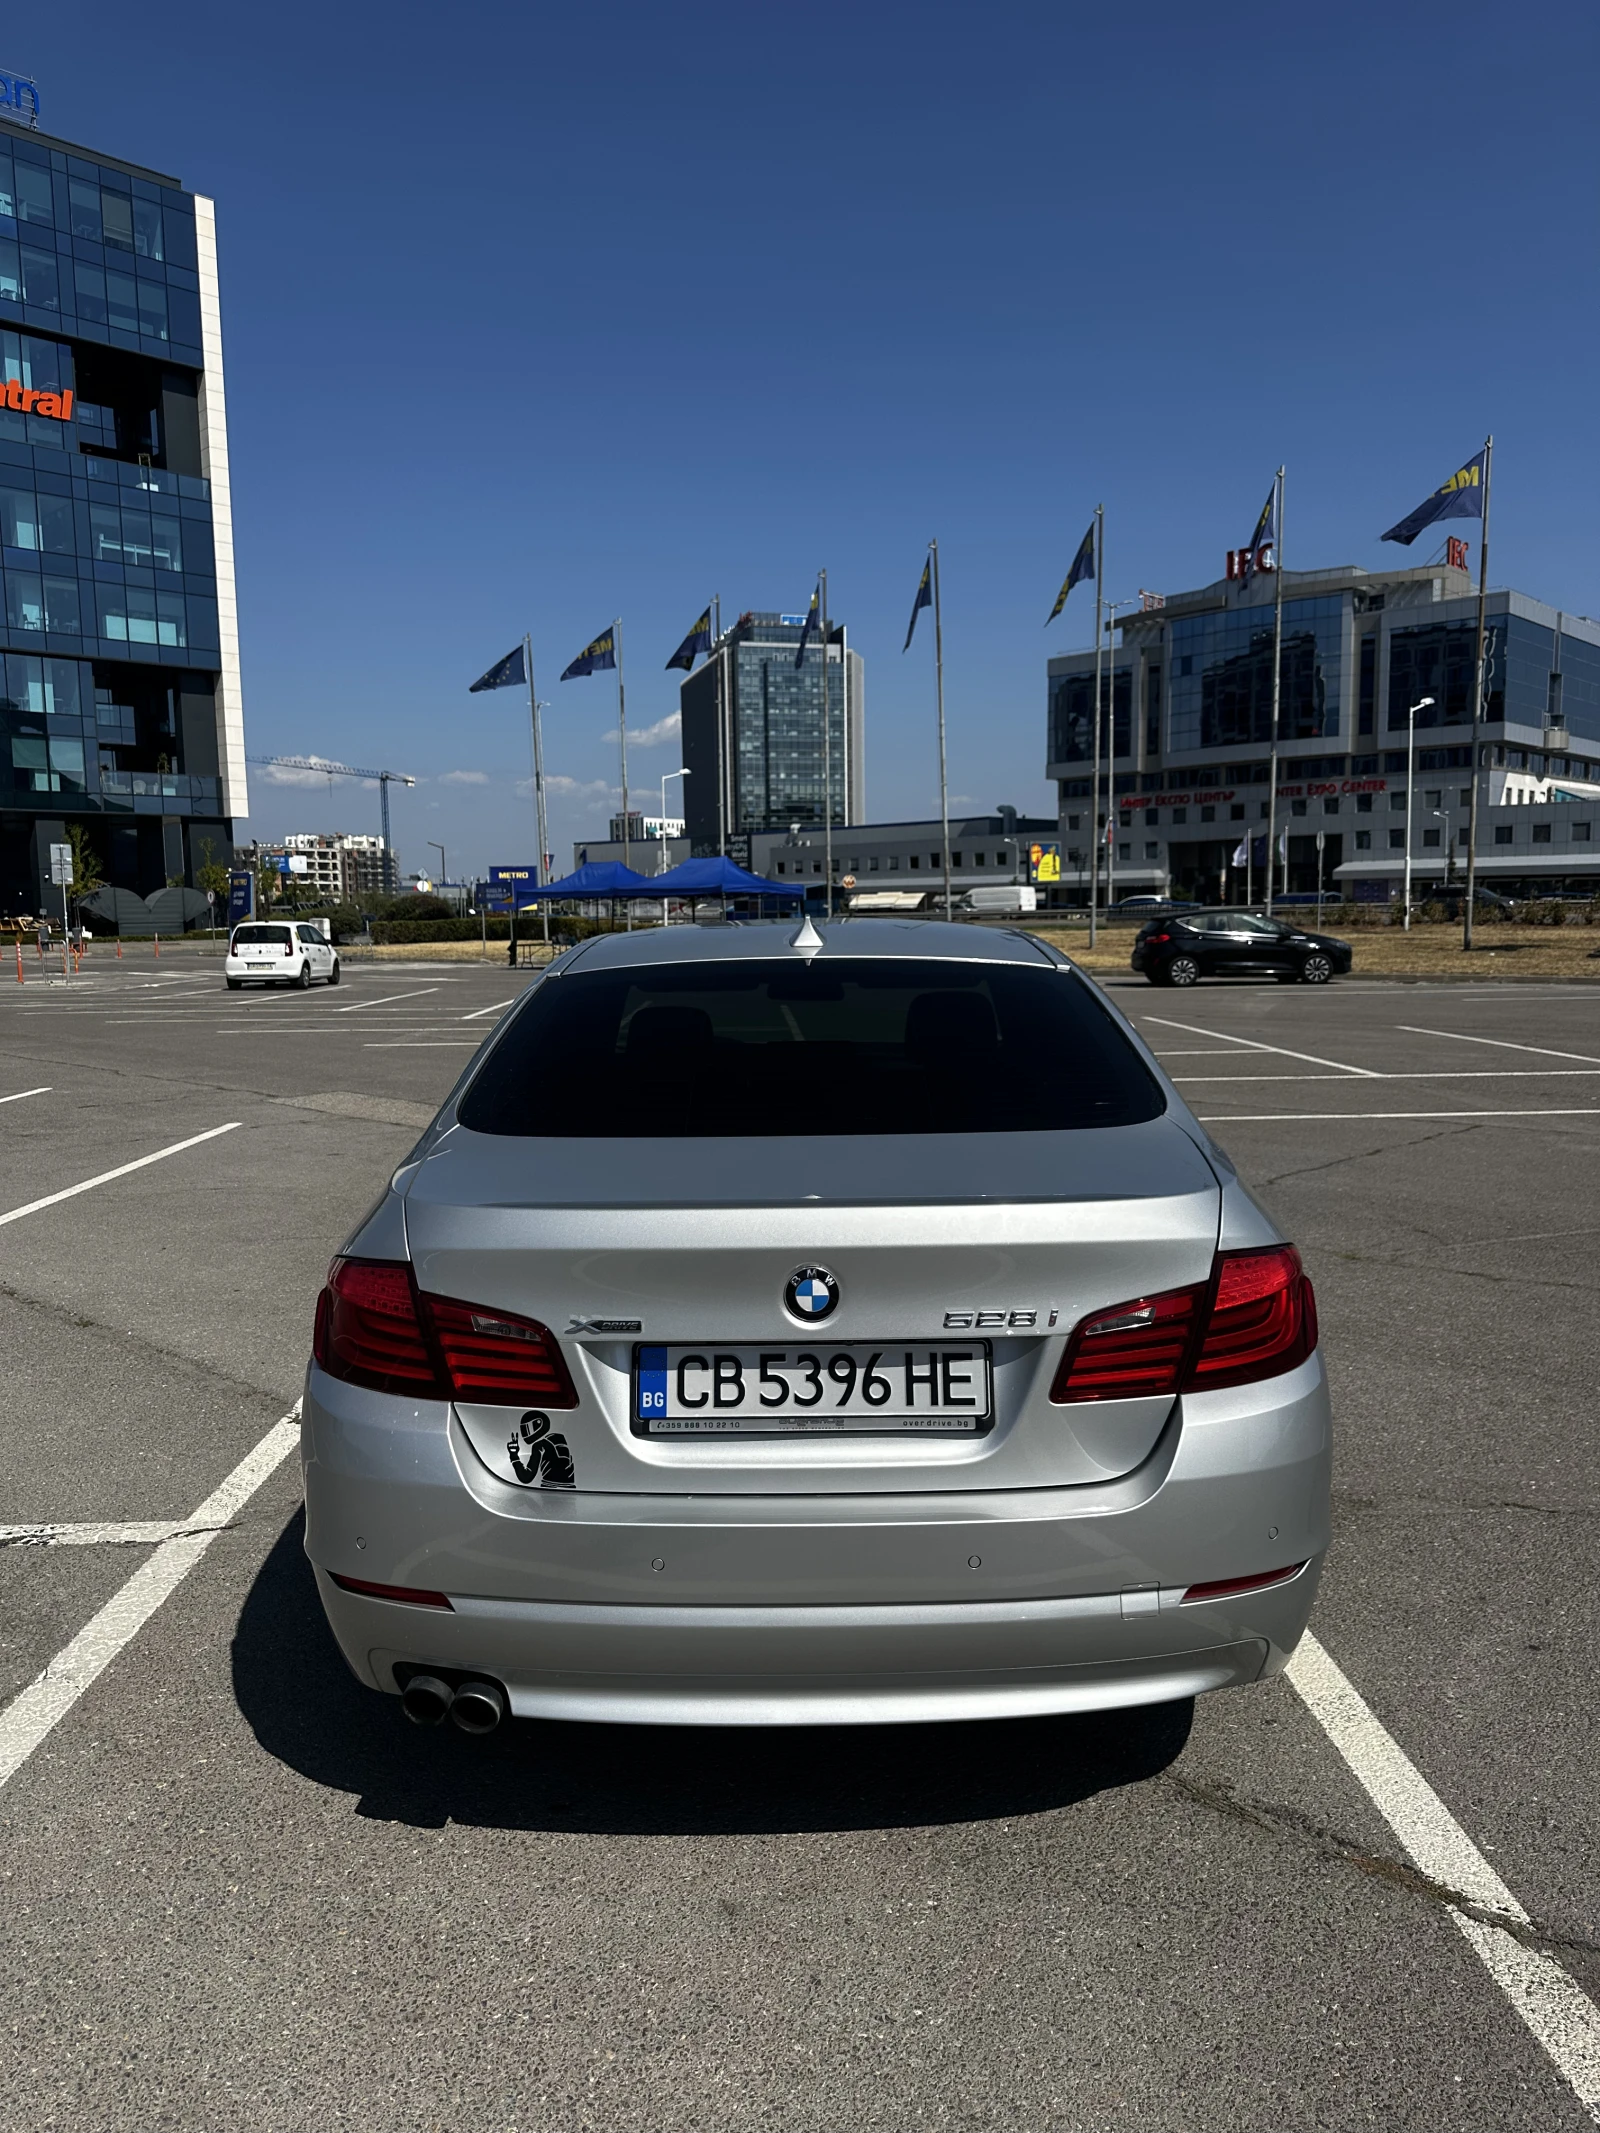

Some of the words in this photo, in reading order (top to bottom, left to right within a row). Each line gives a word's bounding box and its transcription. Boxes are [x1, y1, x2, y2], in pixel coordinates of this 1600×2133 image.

[1446, 536, 1468, 572] IEC
[498, 871, 529, 879] METRO
[791, 1268, 836, 1287] BMW
[677, 1354, 746, 1409] CB
[759, 1352, 893, 1408] 5396
[905, 1352, 976, 1407] HE
[642, 1391, 665, 1409] BG
[730, 1421, 740, 1429] 10
[902, 1419, 969, 1428] overdrive.bg
